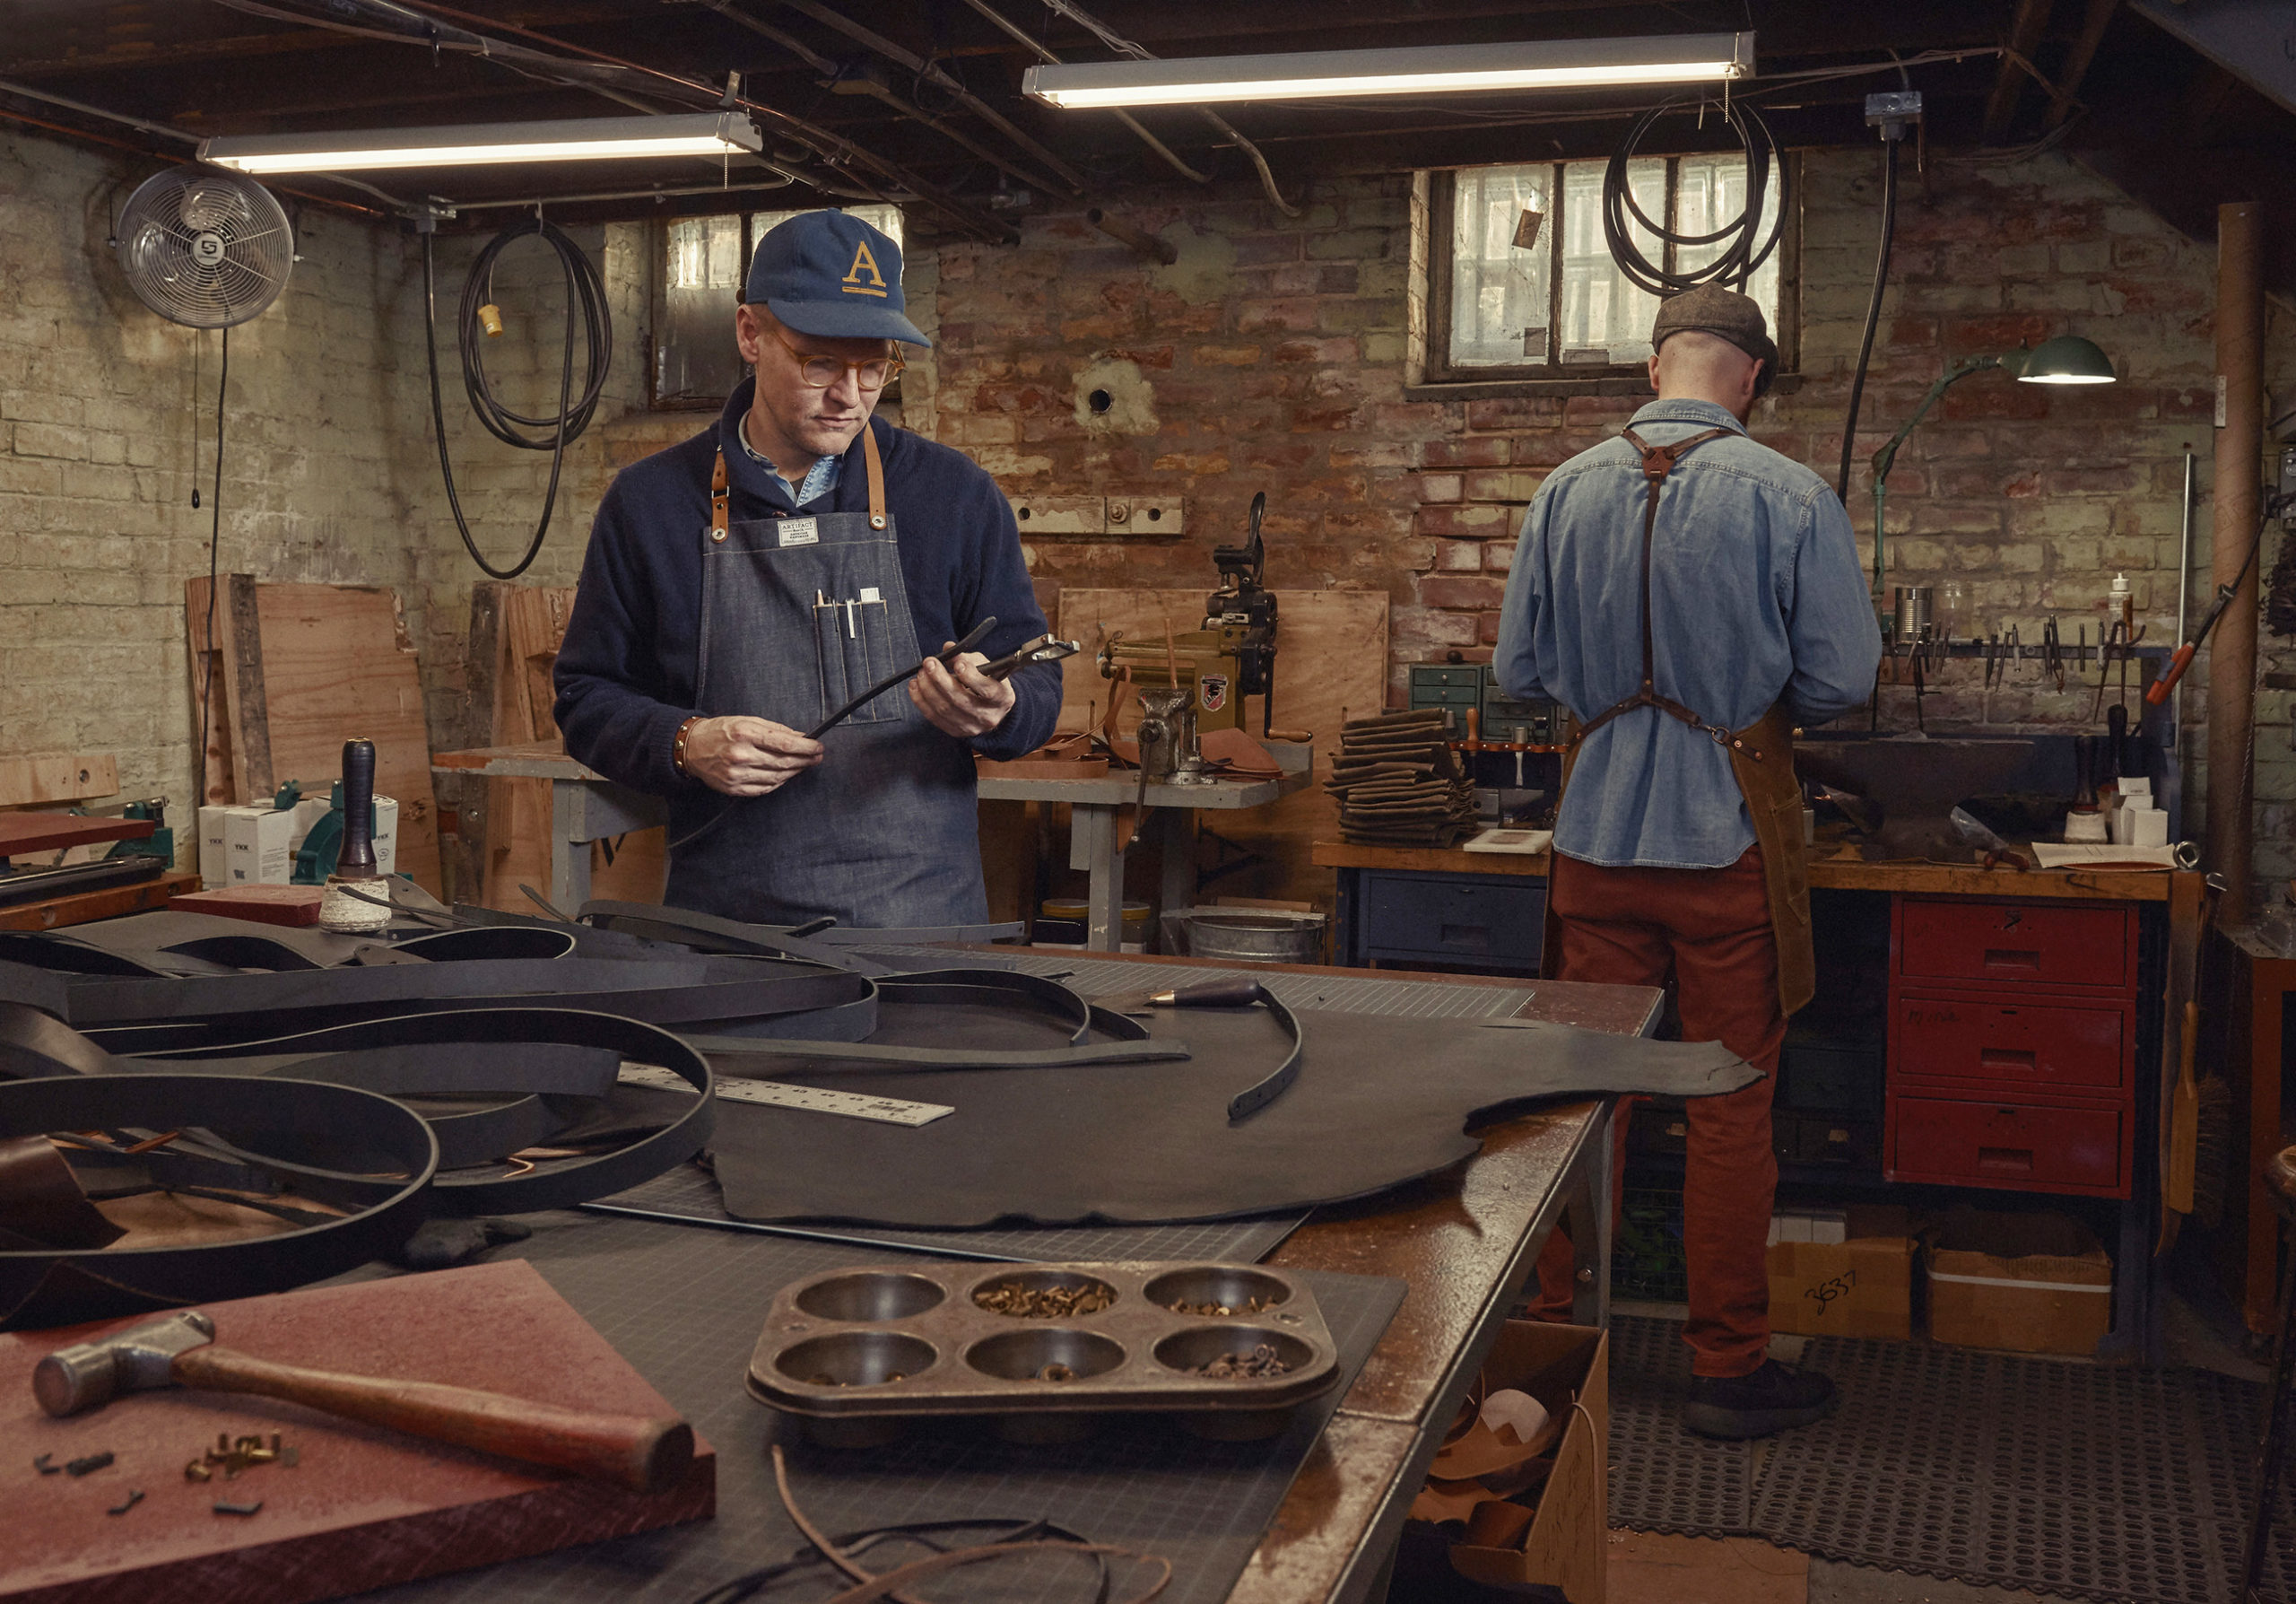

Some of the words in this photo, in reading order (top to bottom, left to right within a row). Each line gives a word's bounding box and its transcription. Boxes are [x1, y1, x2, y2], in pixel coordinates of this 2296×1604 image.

[841, 240, 887, 288] A
[234, 843, 249, 851] YKK
[1805, 1269, 1856, 1316] 3637
